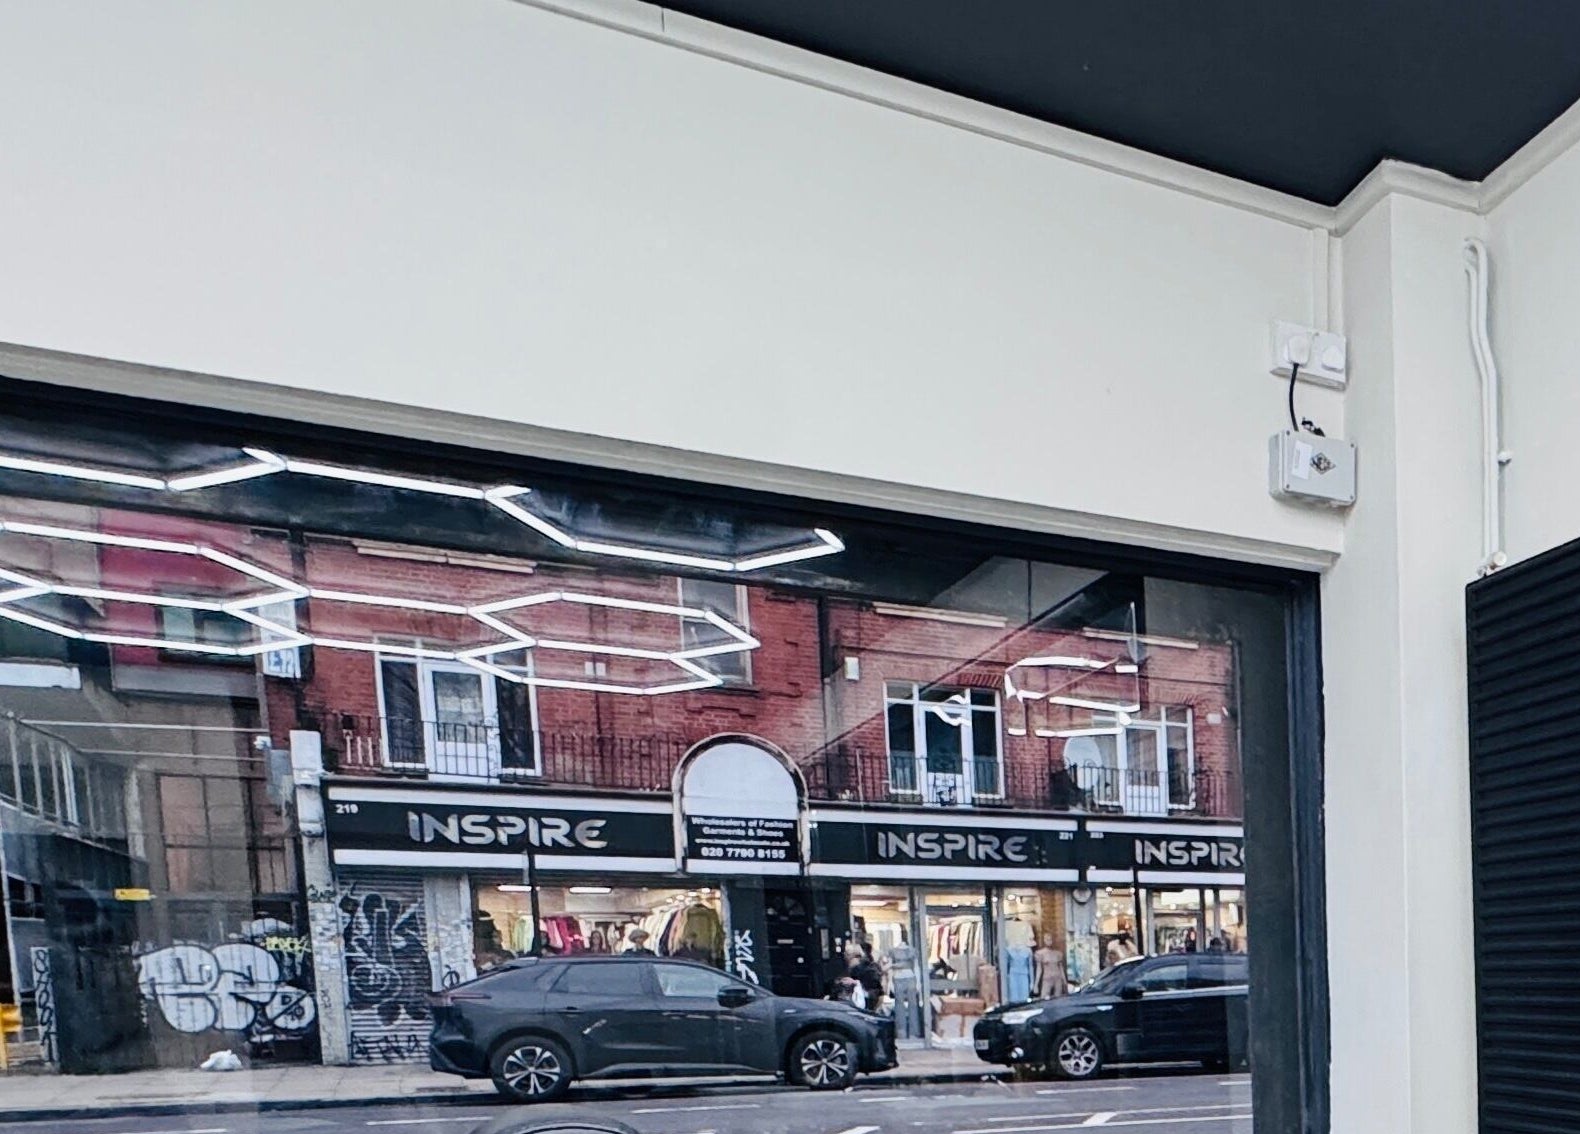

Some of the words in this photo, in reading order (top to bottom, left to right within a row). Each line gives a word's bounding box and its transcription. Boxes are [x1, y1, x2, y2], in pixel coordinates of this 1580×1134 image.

[335, 803, 359, 815] 219
[407, 810, 609, 849] INSPIRE
[877, 831, 1029, 863] INSPIRE
[1134, 838, 1244, 867] INSPIR
